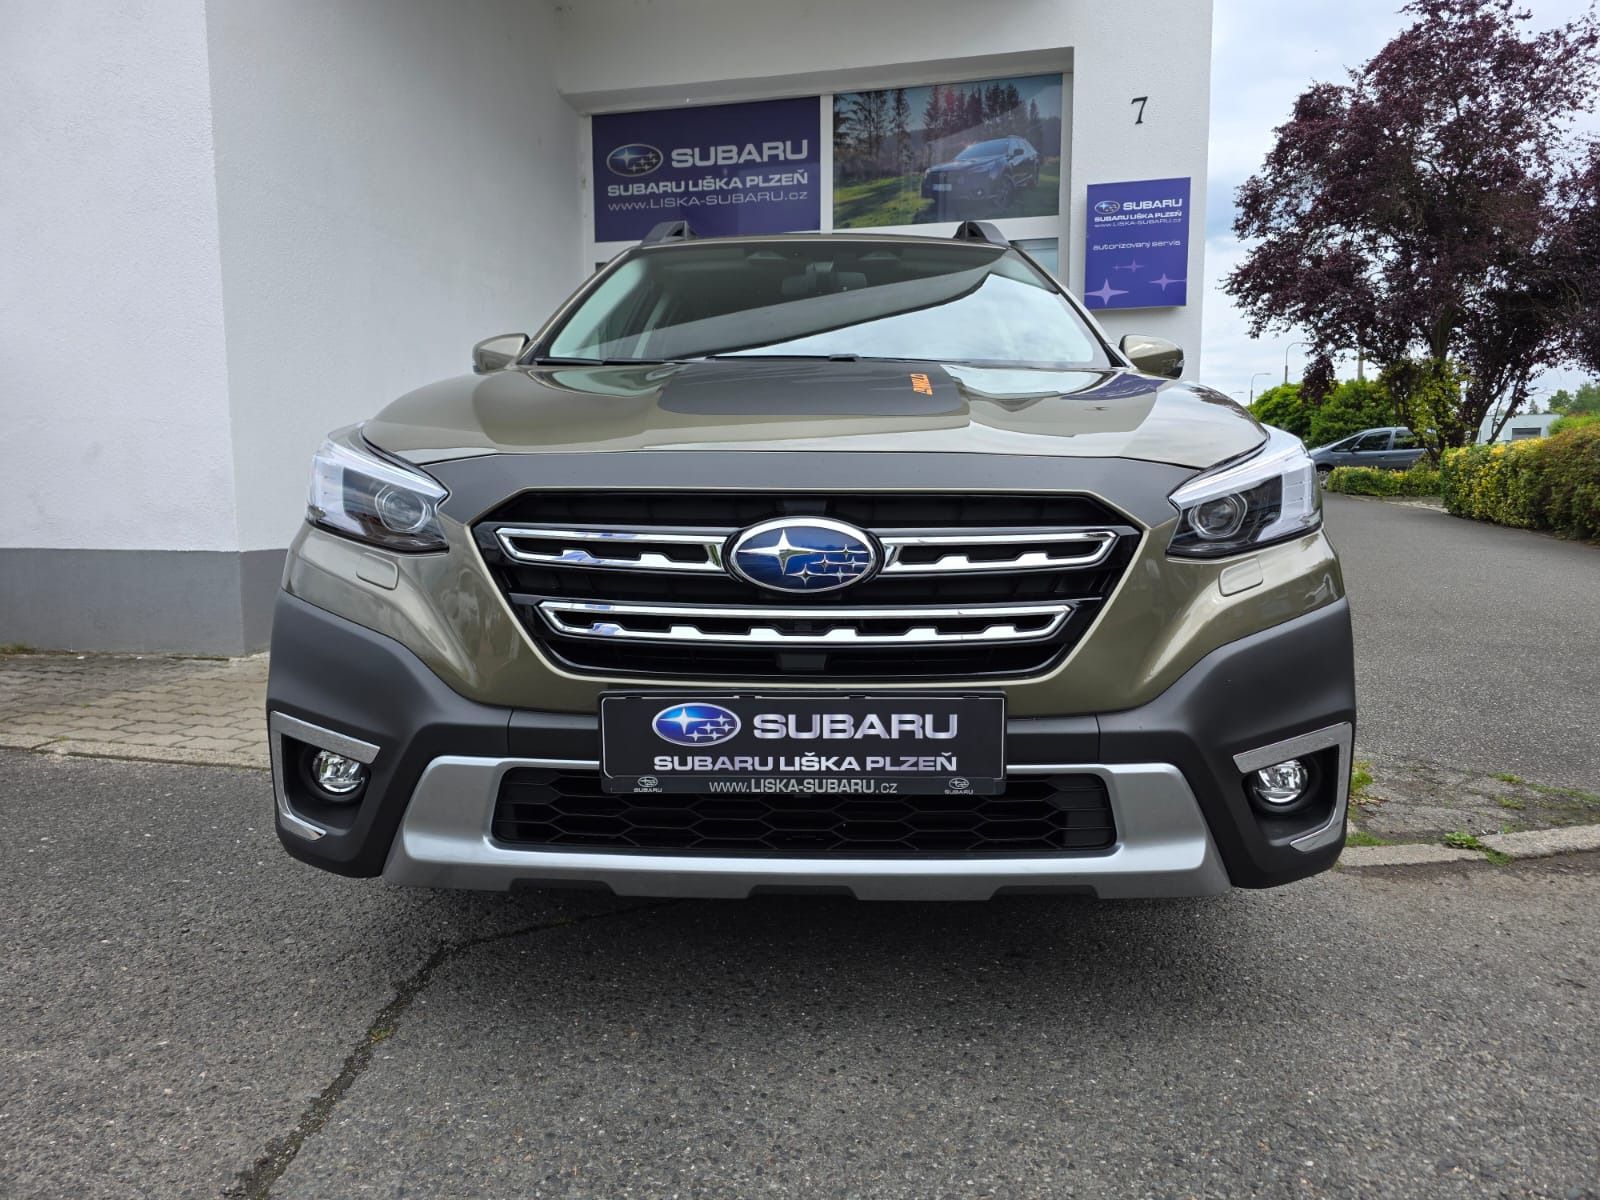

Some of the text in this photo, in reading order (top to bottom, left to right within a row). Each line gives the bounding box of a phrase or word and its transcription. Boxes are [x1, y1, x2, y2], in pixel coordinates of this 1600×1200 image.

[1131, 96, 1148, 124] 7
[671, 139, 808, 168] SUBARU
[607, 169, 808, 197] SUBARU LIŠKA PLZEŇ
[608, 191, 807, 211] www.LISKA-SUBARU.cz
[1123, 198, 1183, 211] SUBARU
[1094, 209, 1182, 222] SUBARU LIŠKA PLZEŇ
[1093, 240, 1181, 251] autorizovaný servis
[753, 713, 958, 739] SUBARU
[653, 752, 957, 771] SUBARU LIŠKA PLZEŇ
[708, 778, 898, 794] www.LISKA-SUBARU.cz
